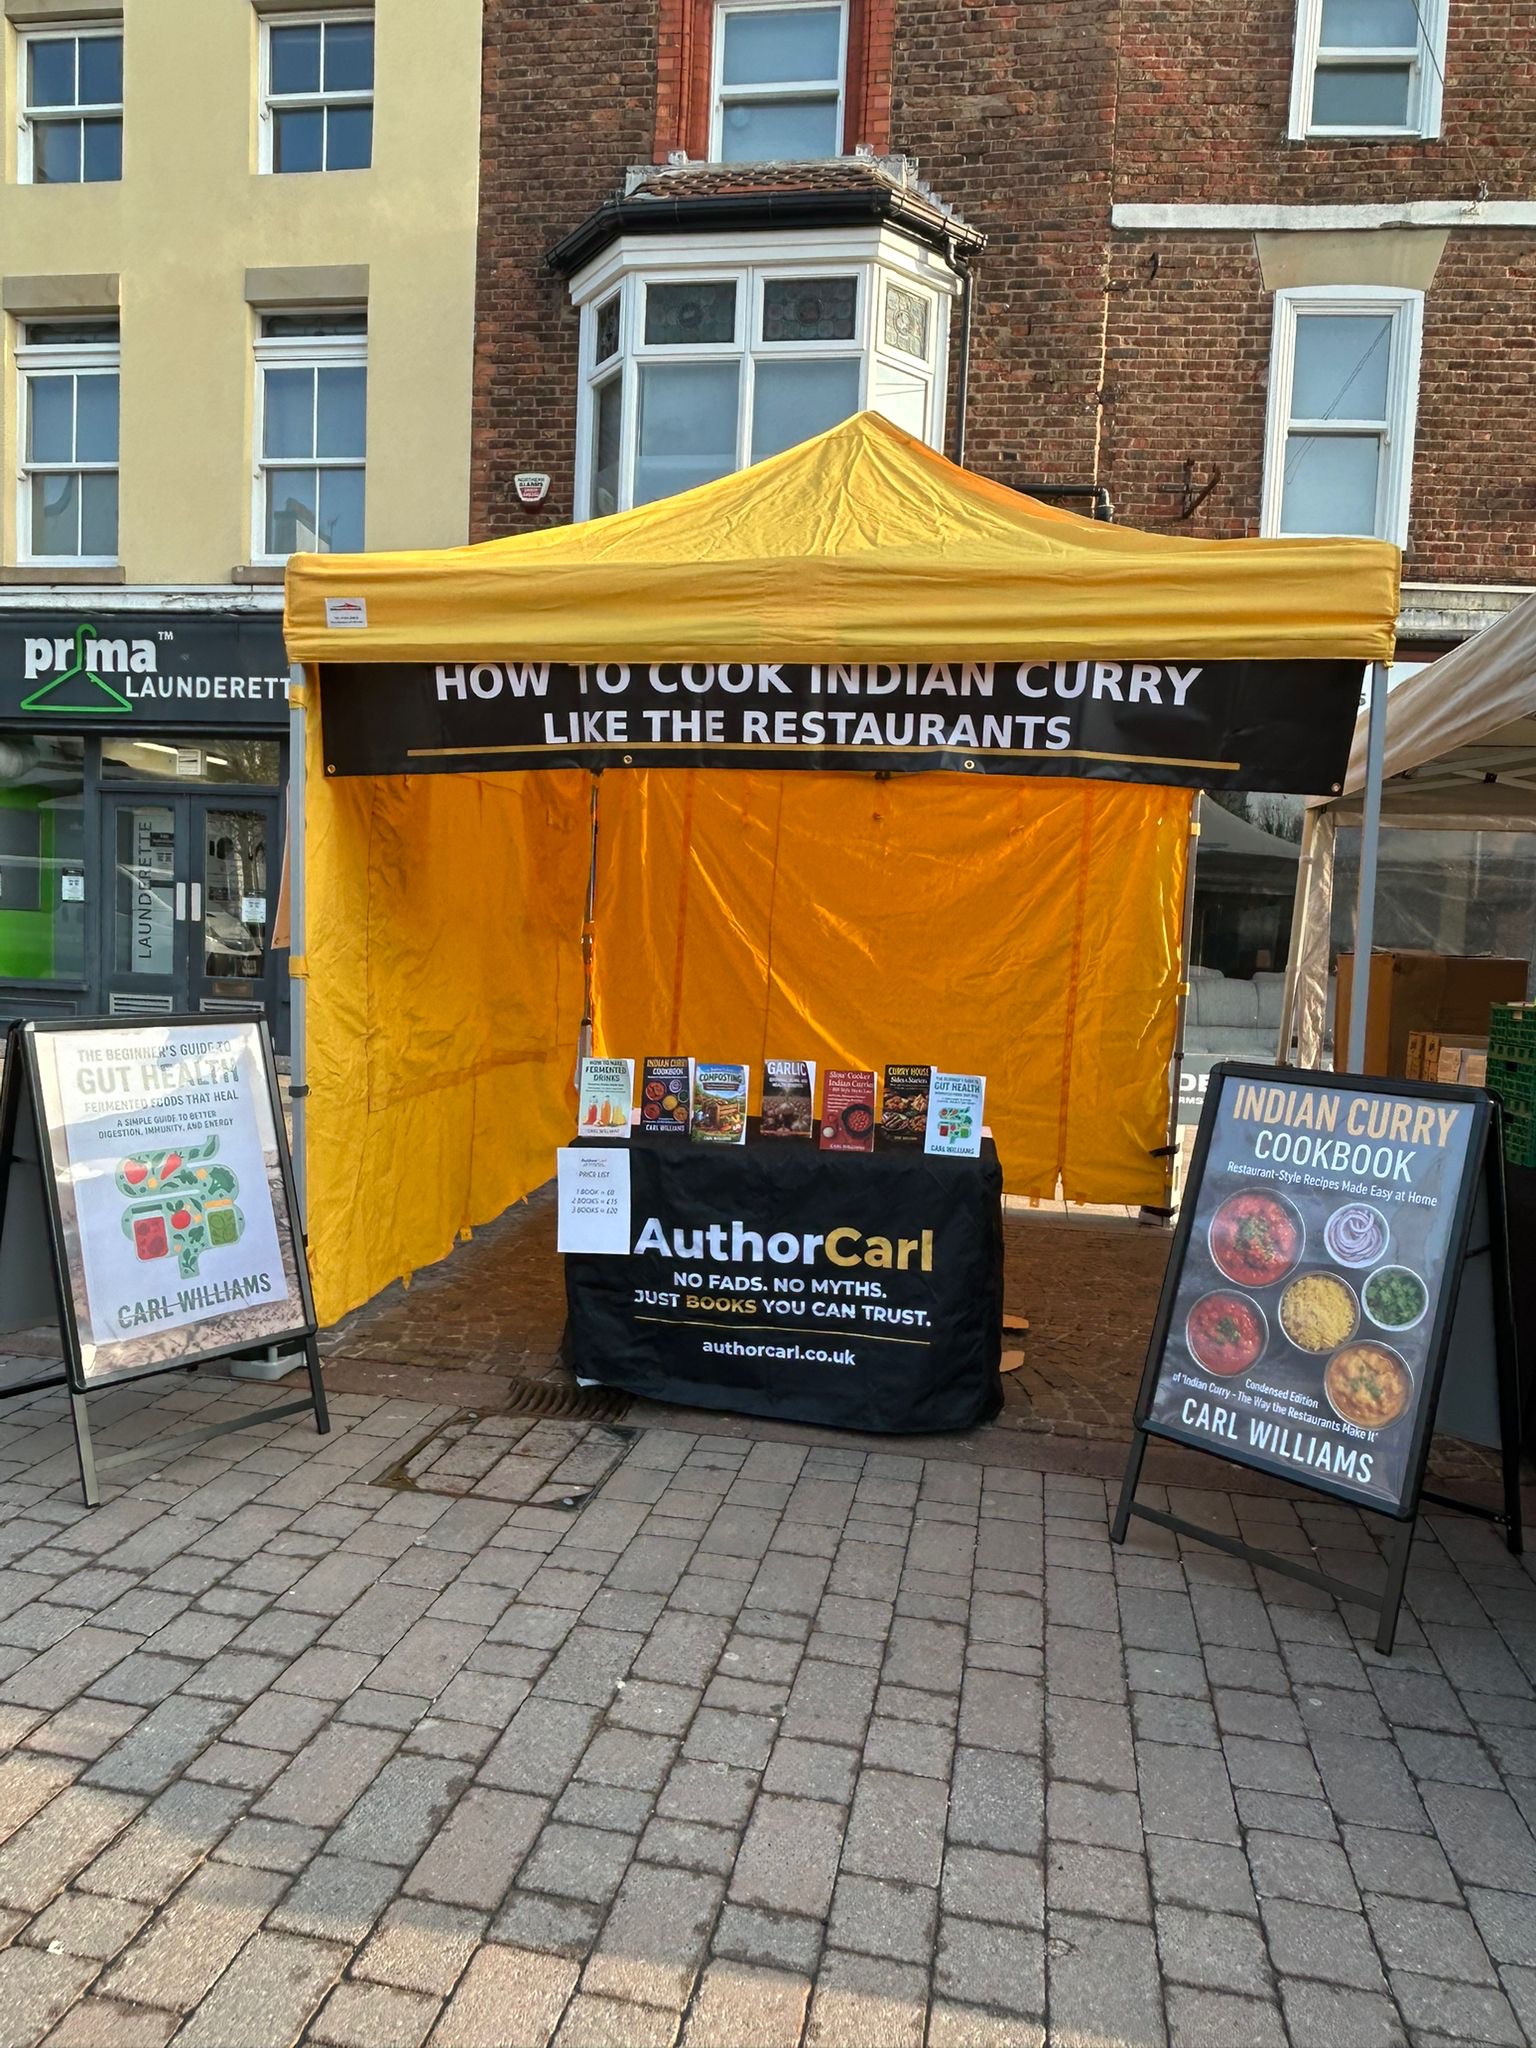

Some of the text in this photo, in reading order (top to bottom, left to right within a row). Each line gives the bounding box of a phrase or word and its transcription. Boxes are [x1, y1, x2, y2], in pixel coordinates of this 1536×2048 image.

[126, 676, 291, 699] LAUNDERETT
[435, 661, 1203, 706] HOW TO COOK INDIAN CURRY
[543, 710, 1071, 750] LIKE THE RESTAURANTS
[138, 821, 152, 959] LAUNDERETTE
[79, 1040, 231, 1062] THE BEGINNER'S GUIDE TO
[647, 1059, 669, 1067] INDIAN
[76, 1056, 239, 1095] GUT HEALTH
[586, 1066, 627, 1074] FERMENTED
[593, 1074, 620, 1082] DRINKS
[699, 1073, 742, 1081] COMPOSTING
[767, 1061, 807, 1075] GARLIC
[829, 1071, 871, 1080] Slow Cooker
[888, 1066, 929, 1076] CURRY HOUSE
[934, 1081, 951, 1091] GUT
[952, 1083, 980, 1093] HEALTH
[84, 1089, 239, 1113] FERMENTED FOODS THAT HEAL
[98, 1118, 234, 1139] DIGESTION, IMMUNITY, AND ENERGY
[117, 1110, 217, 1128] A SIMPLE GUIDE TO BETTER
[1232, 1084, 1460, 1148] INDIAN CURRY
[1254, 1129, 1416, 1183] COOKBOOK
[1227, 1161, 1438, 1208] Restaurant-Style Recipes Made Easy at Home
[633, 1217, 934, 1272] AuthorCarl
[673, 1271, 887, 1299] NO FADS. NO MYTHS.
[118, 1273, 272, 1329] CARL WILLIAMS
[634, 1289, 932, 1327] JUST BOOKS YOU CAN TRUST.
[702, 1339, 857, 1366] authorcarl.co.uk
[1172, 1372, 1181, 1383] of
[1208, 1382, 1231, 1399] Curry
[1237, 1389, 1252, 1405] The
[1253, 1396, 1271, 1413] Way
[1272, 1399, 1287, 1414] the
[1287, 1405, 1341, 1432] Restaurants
[1342, 1423, 1367, 1441] Make
[1245, 1378, 1319, 1409] Condensed Edition
[1181, 1398, 1374, 1483] CARL WILLIAMS
